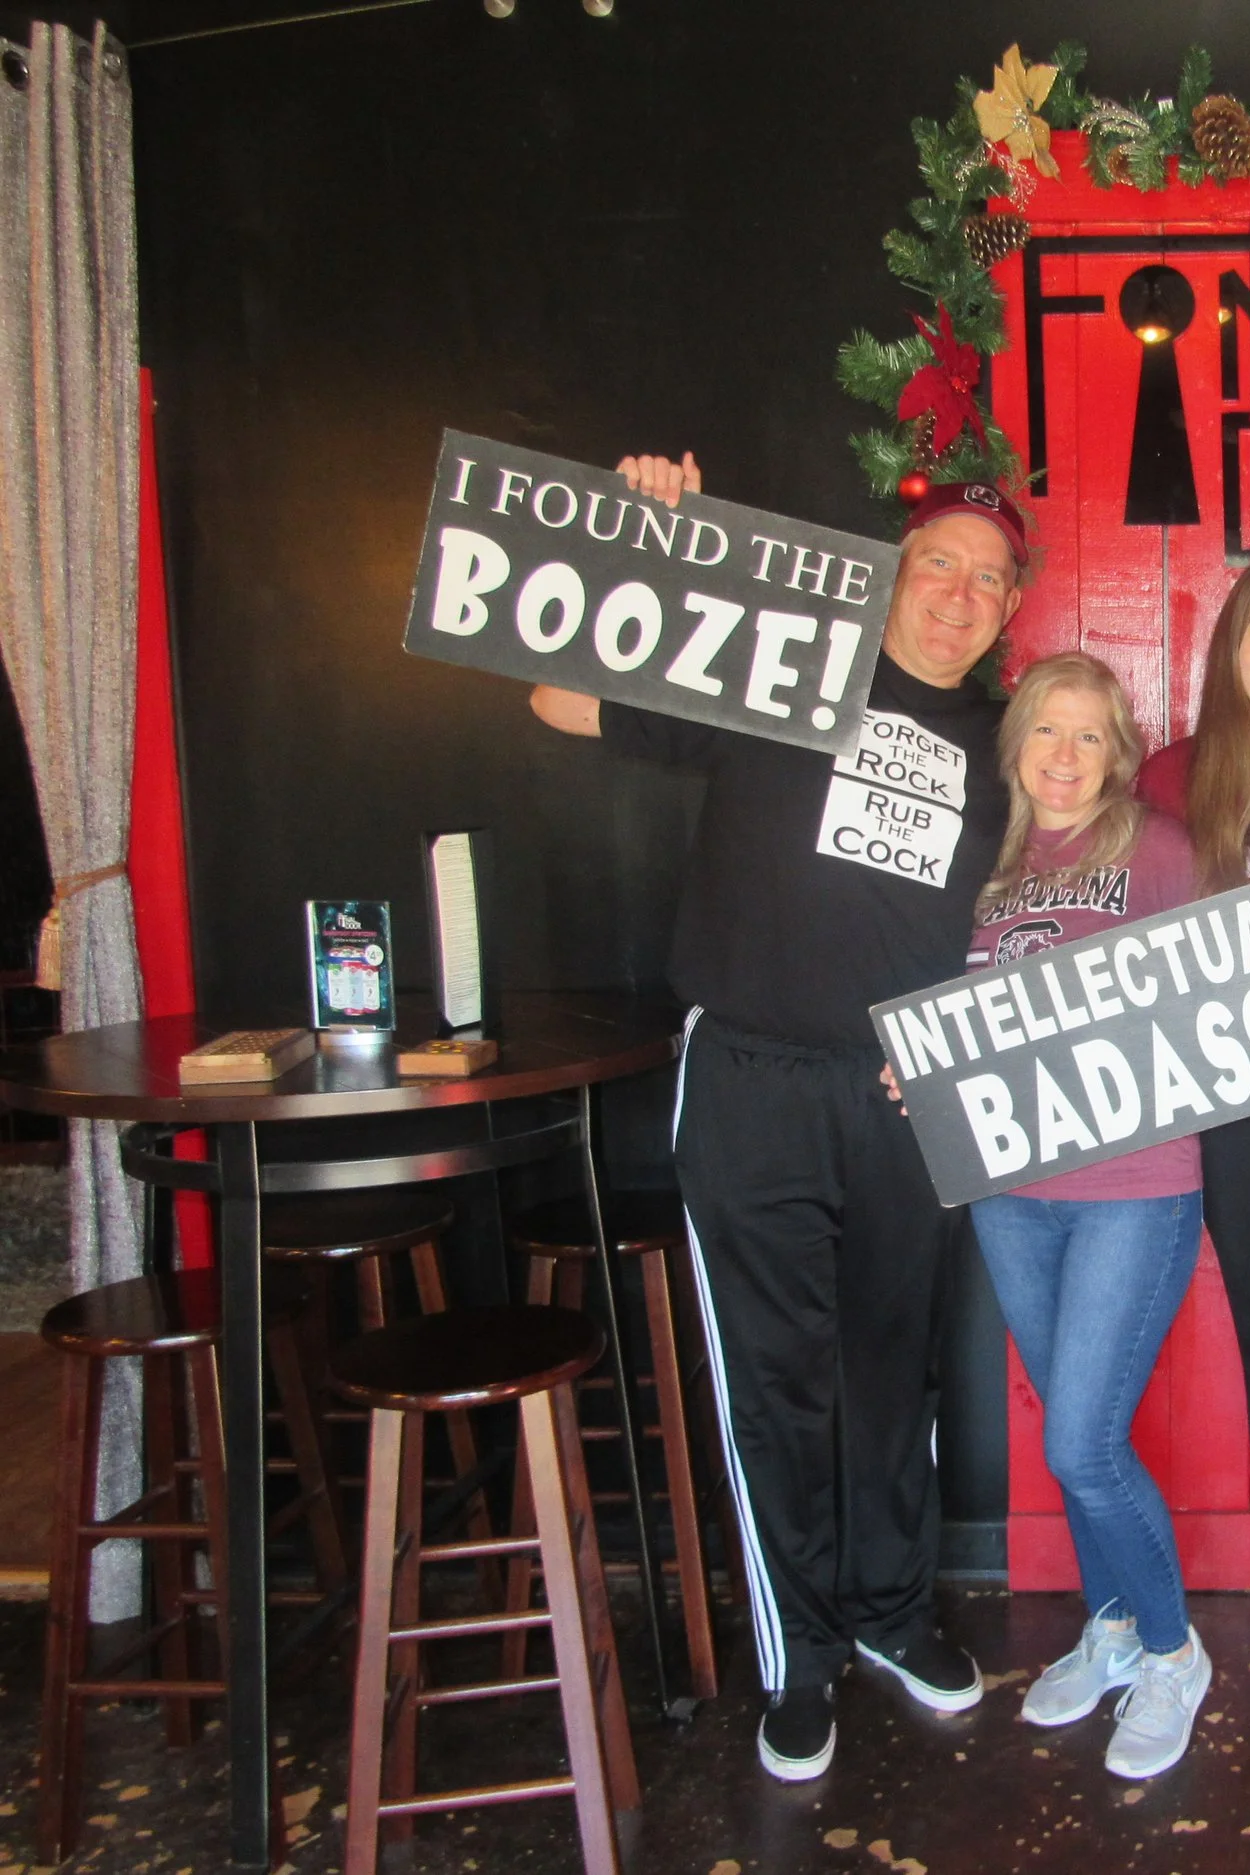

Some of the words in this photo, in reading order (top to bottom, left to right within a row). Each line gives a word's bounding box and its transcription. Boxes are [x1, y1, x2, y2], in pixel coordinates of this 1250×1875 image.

[448, 457, 479, 505] I
[491, 468, 730, 567] FOUND
[751, 534, 874, 606] THE
[432, 526, 863, 731] BOOZE!
[855, 748, 951, 799] ROCK
[889, 744, 927, 768] THE
[864, 790, 932, 830] RUB
[875, 816, 914, 842] THE
[832, 826, 942, 881] COCK
